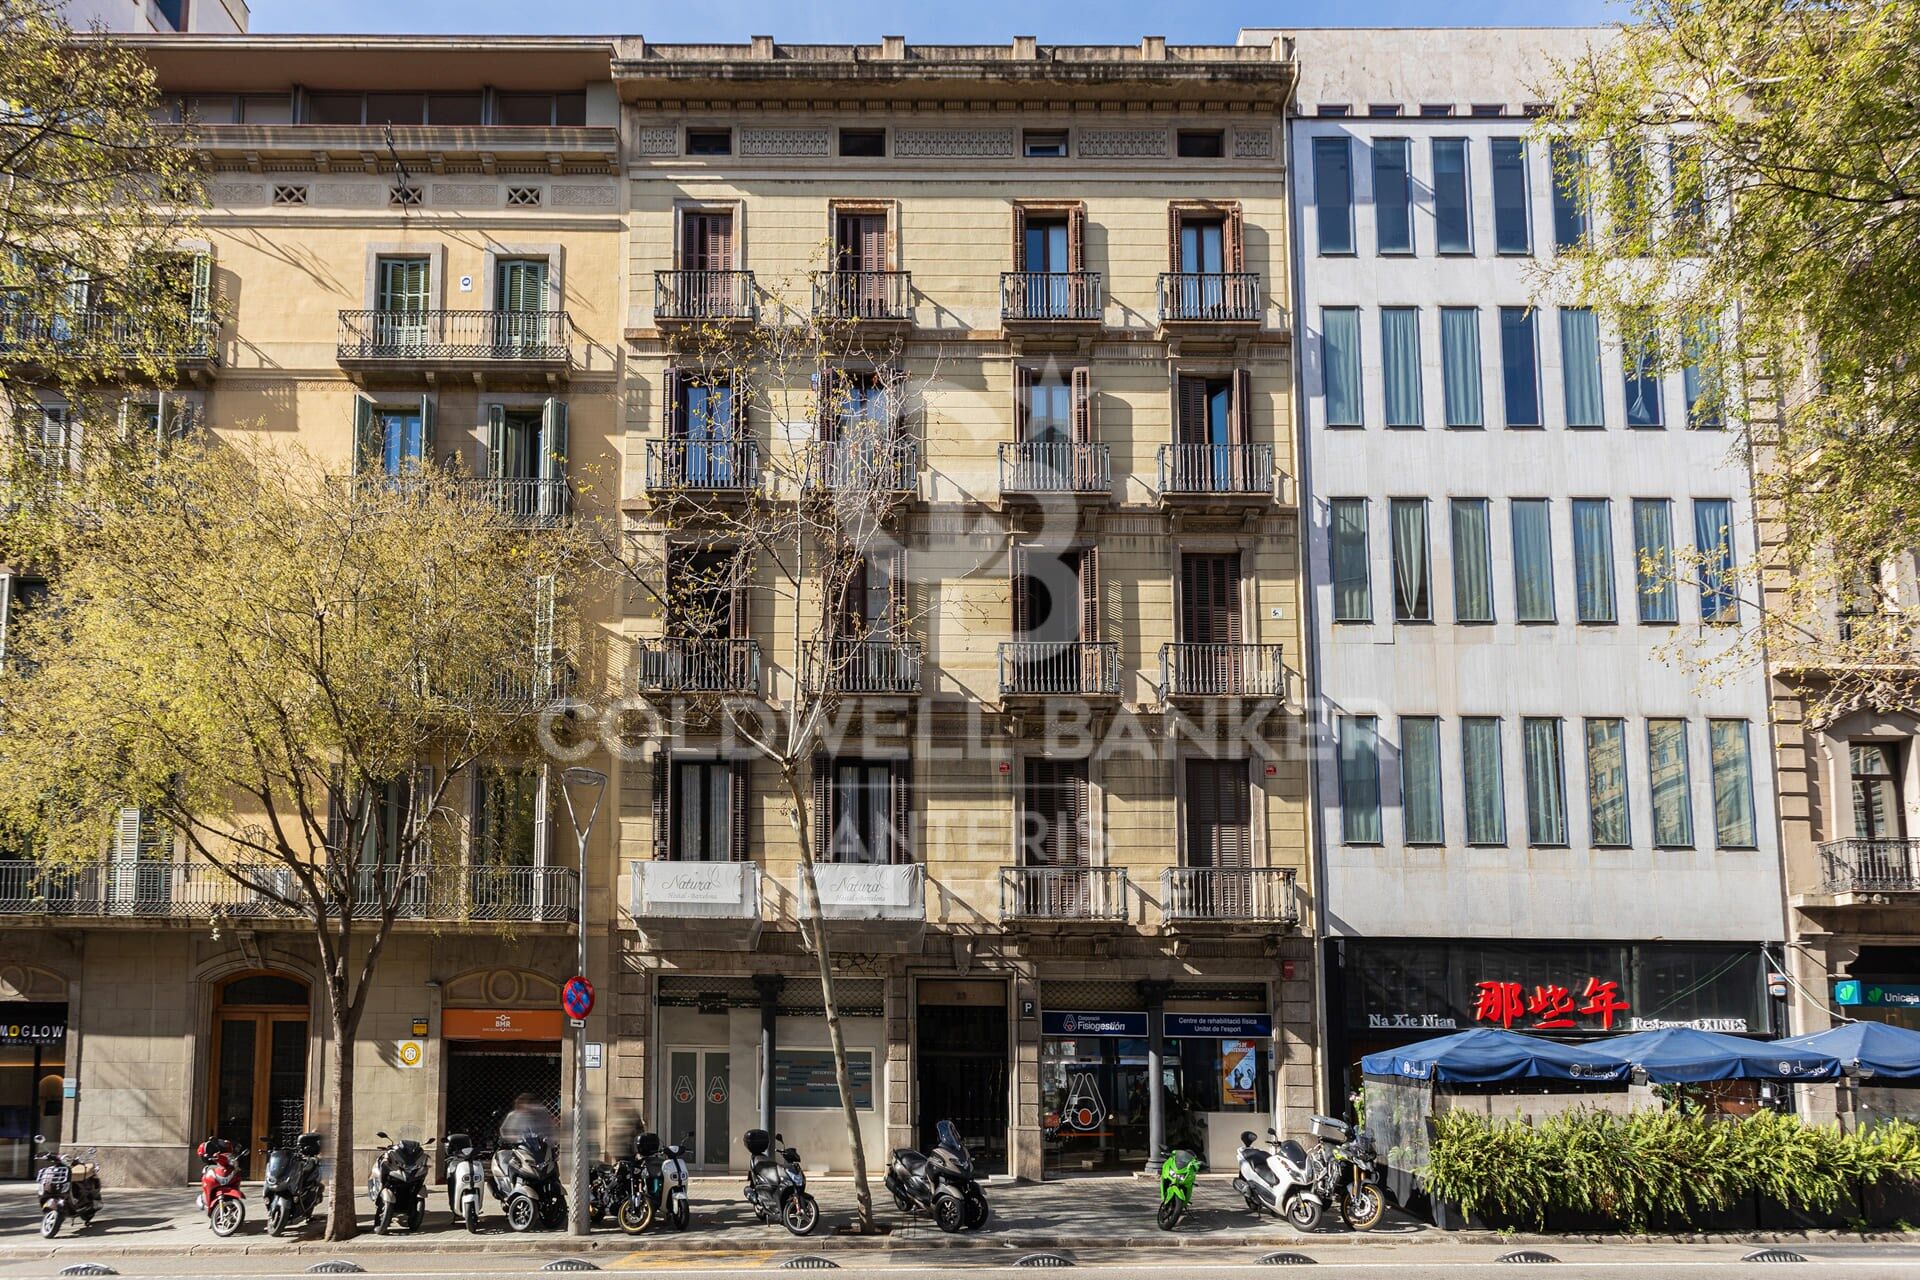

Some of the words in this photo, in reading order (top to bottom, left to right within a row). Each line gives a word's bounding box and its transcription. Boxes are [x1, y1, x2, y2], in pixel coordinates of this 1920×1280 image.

[661, 873, 712, 892] Natura
[829, 876, 881, 893] Natura
[1474, 976, 1630, 1030] 那些年
[1884, 993, 1920, 1004] Unicaja
[1024, 1003, 1033, 1012] P
[495, 1020, 511, 1028] BMR
[1078, 1021, 1126, 1032] Fisiogestión
[1207, 1017, 1240, 1025] rehabilitació
[1369, 1014, 1390, 1028] Na
[1393, 1014, 1418, 1028] Xie
[1422, 1014, 1456, 1028] Nian
